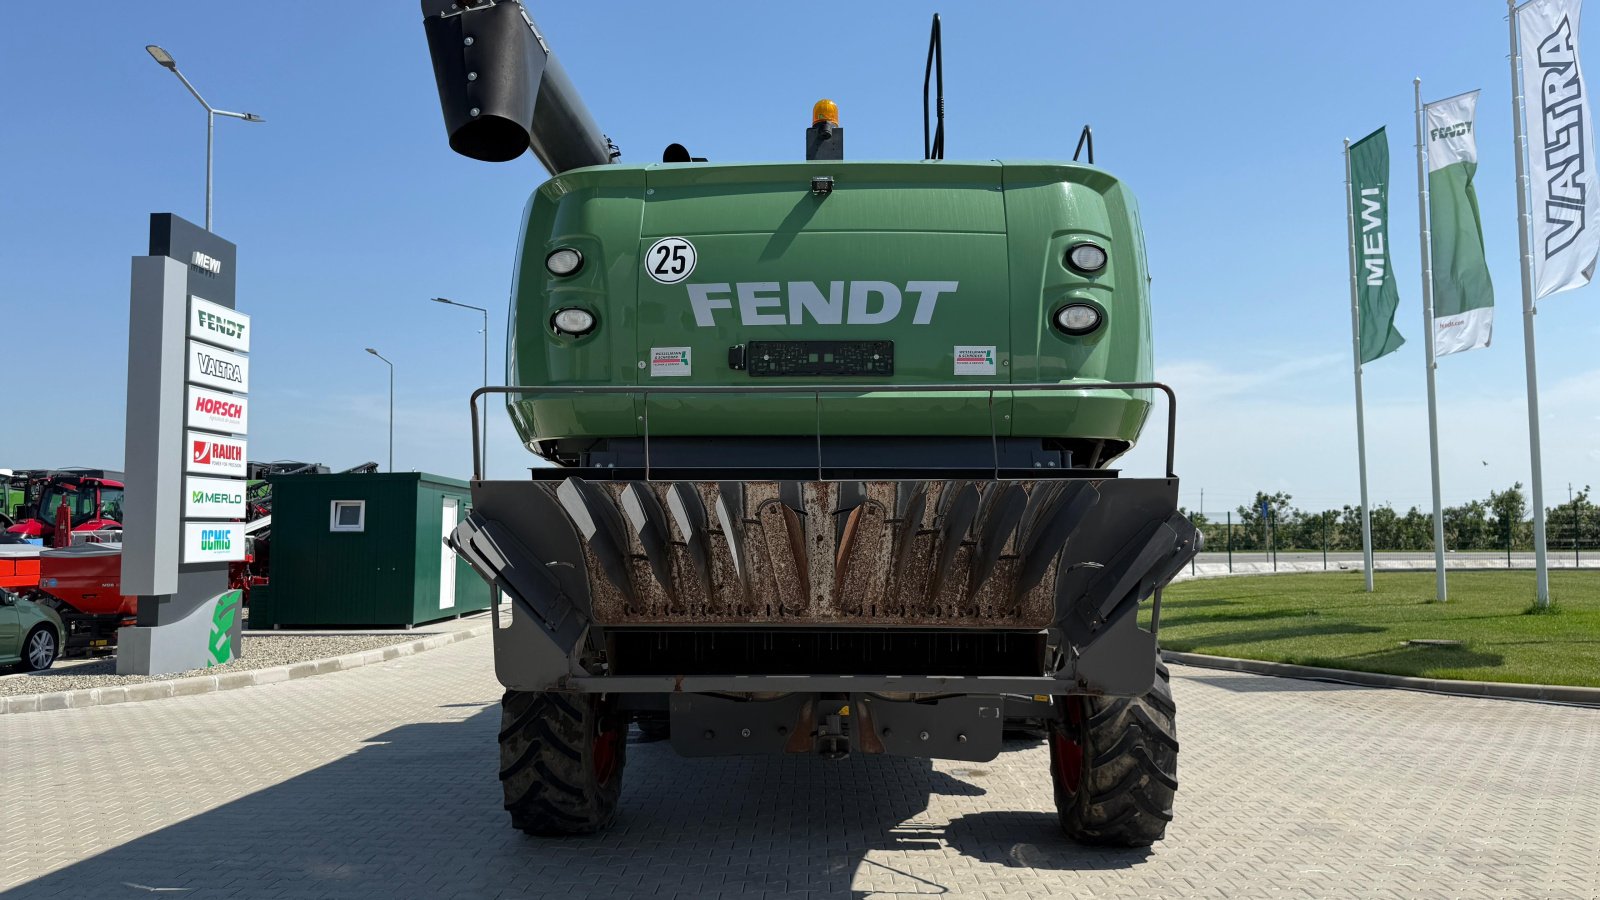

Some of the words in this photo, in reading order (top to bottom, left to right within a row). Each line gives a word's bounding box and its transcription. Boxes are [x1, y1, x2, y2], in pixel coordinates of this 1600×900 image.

[1431, 121, 1472, 141] FENDT
[1537, 14, 1586, 261] VALTRA
[1361, 187, 1385, 286] MEWI
[192, 251, 221, 273] MEWI
[654, 245, 687, 275] 25
[686, 280, 959, 327] FENDT
[198, 310, 245, 339] FENDT
[198, 352, 242, 383] VALTRA
[196, 396, 242, 419] HORSCH
[212, 443, 242, 461] RAUCH
[205, 492, 242, 504] MERLO
[201, 529, 231, 551] OCMIS
